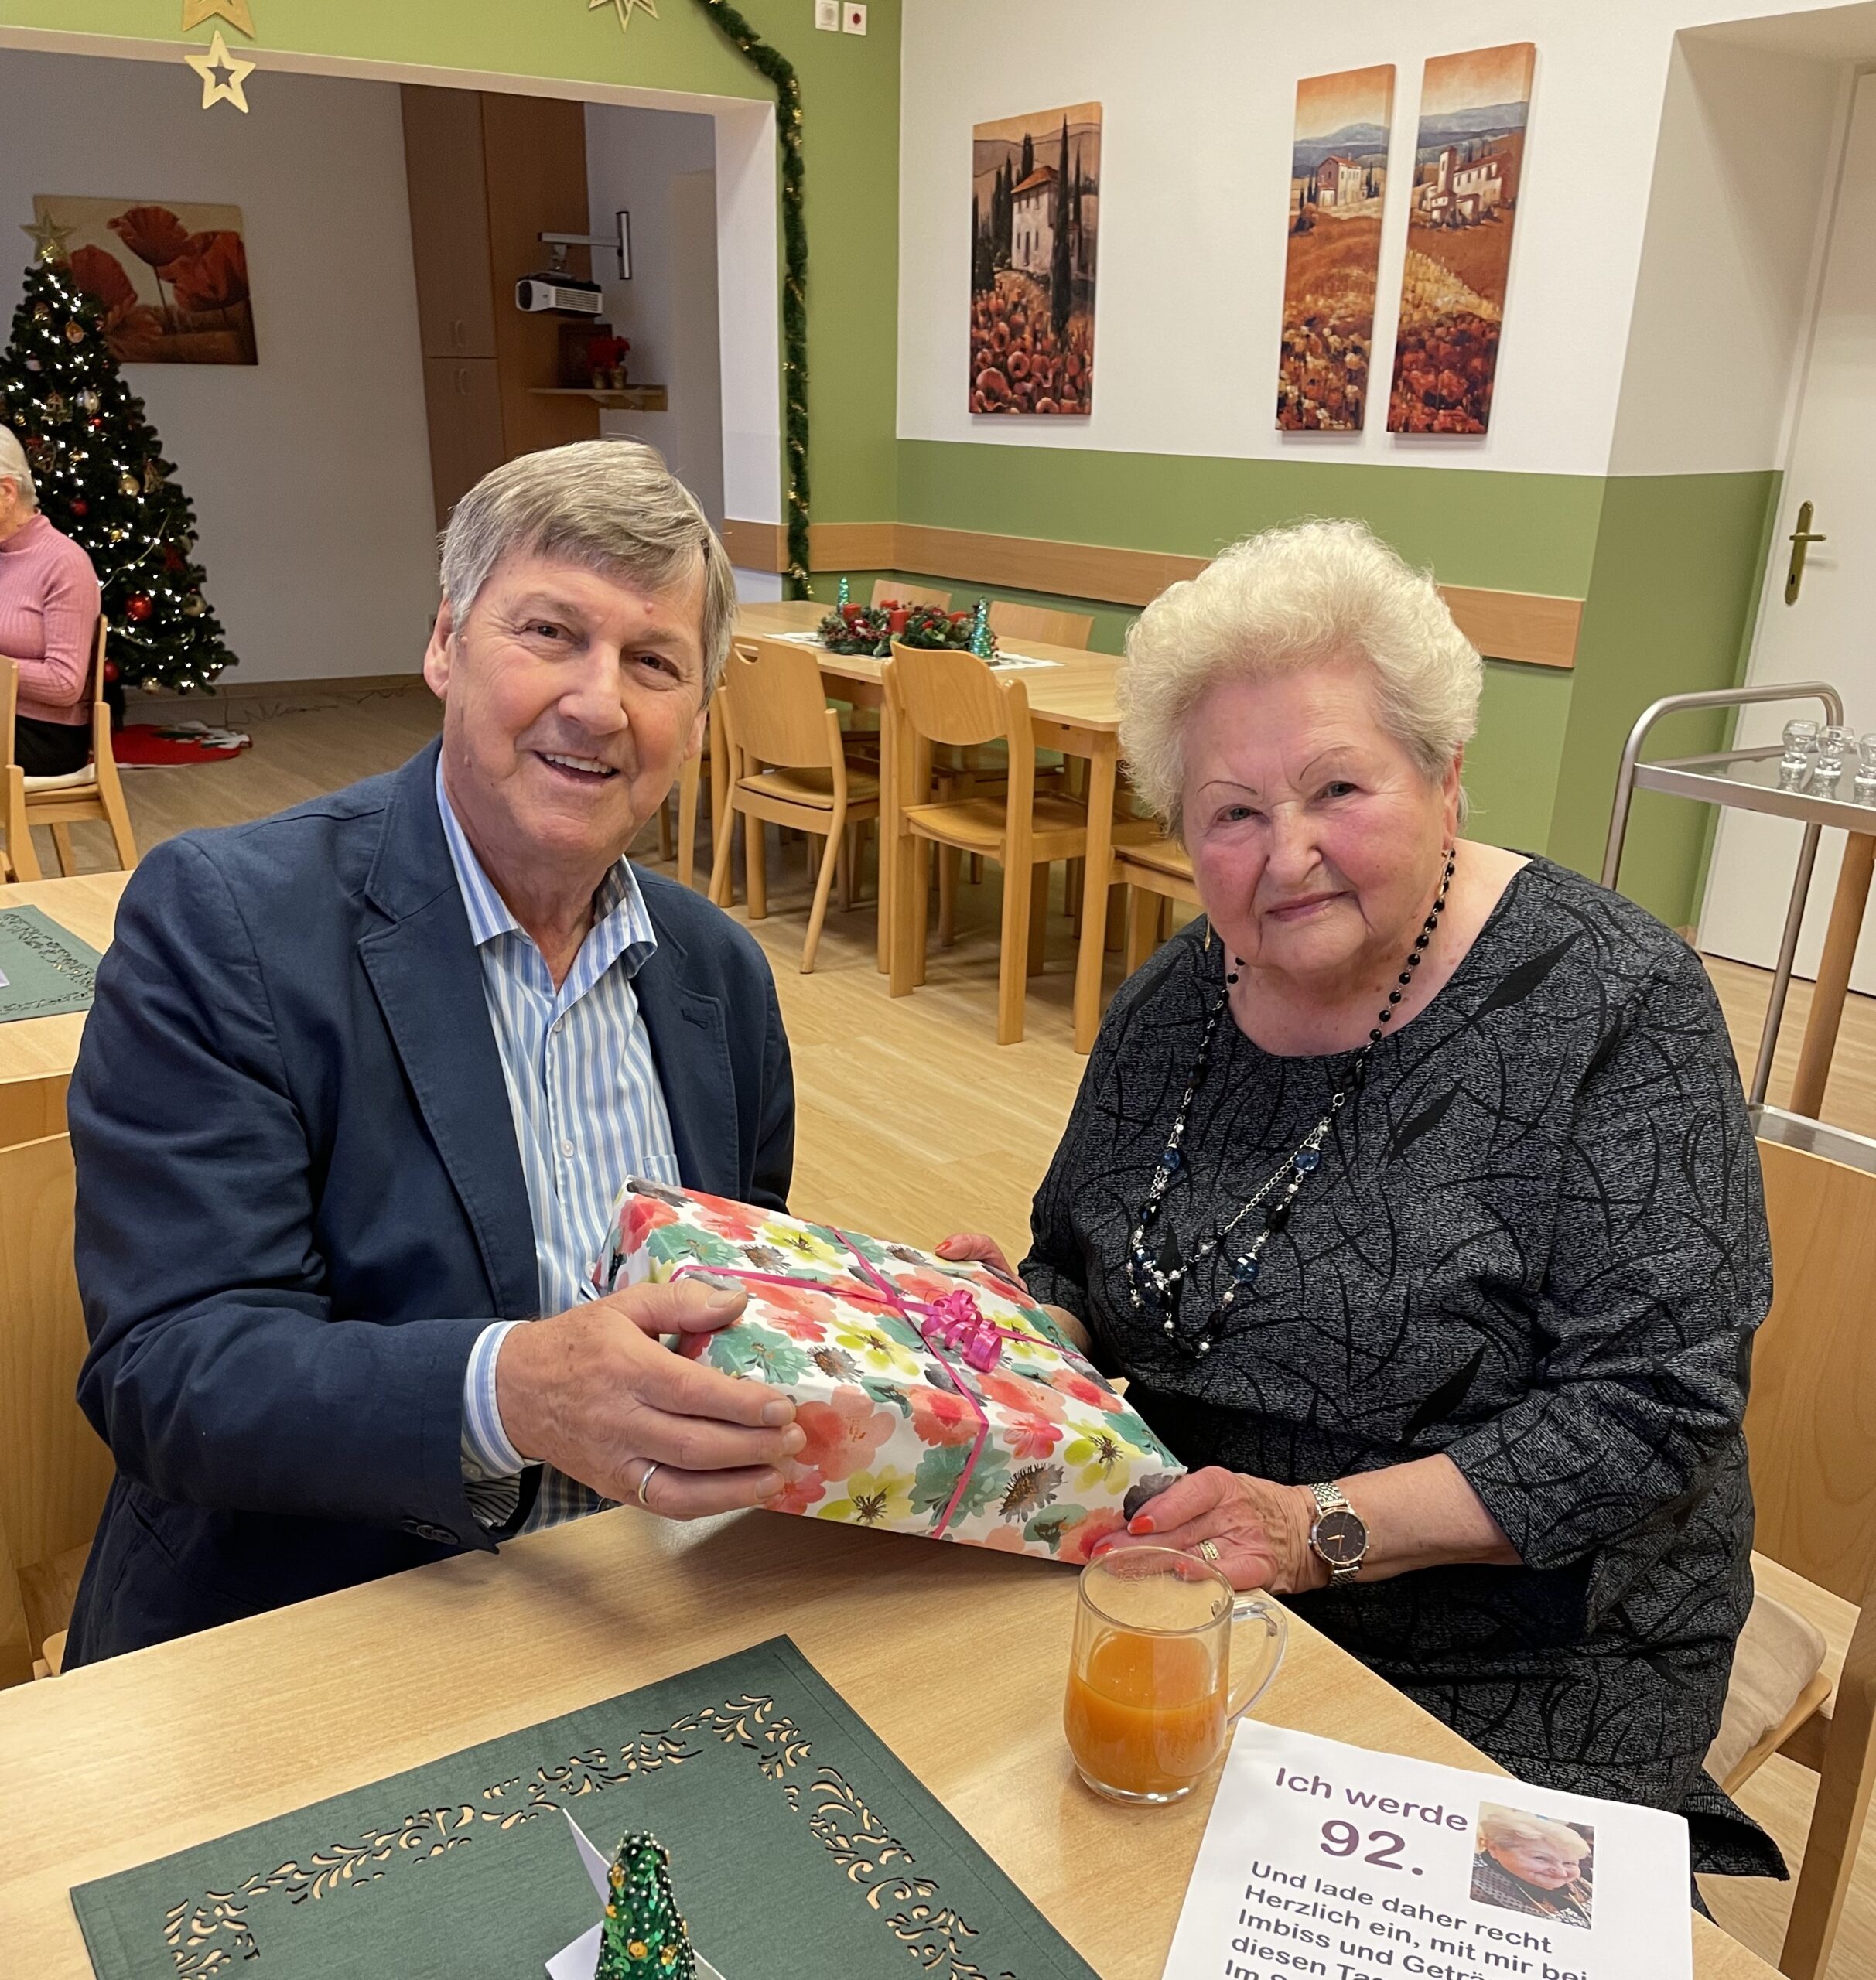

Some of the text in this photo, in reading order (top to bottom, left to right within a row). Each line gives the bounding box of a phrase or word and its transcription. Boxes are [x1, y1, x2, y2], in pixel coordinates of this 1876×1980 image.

[1276, 1767, 1468, 1832] Ich werde
[1320, 1819, 1424, 1876] 92.
[1245, 1884, 1360, 1930] Herzlich
[1369, 1922, 1420, 1949] ein,
[1430, 1937, 1476, 1961] mit
[1484, 1951, 1534, 1974] mir
[1252, 1860, 1553, 1954] Und lade daher recht
[1232, 1936, 1327, 1976] diesen
[1239, 1908, 1331, 1948] Imbiss
[1339, 1941, 1394, 1966] und
[1225, 1959, 1260, 1980] Im
